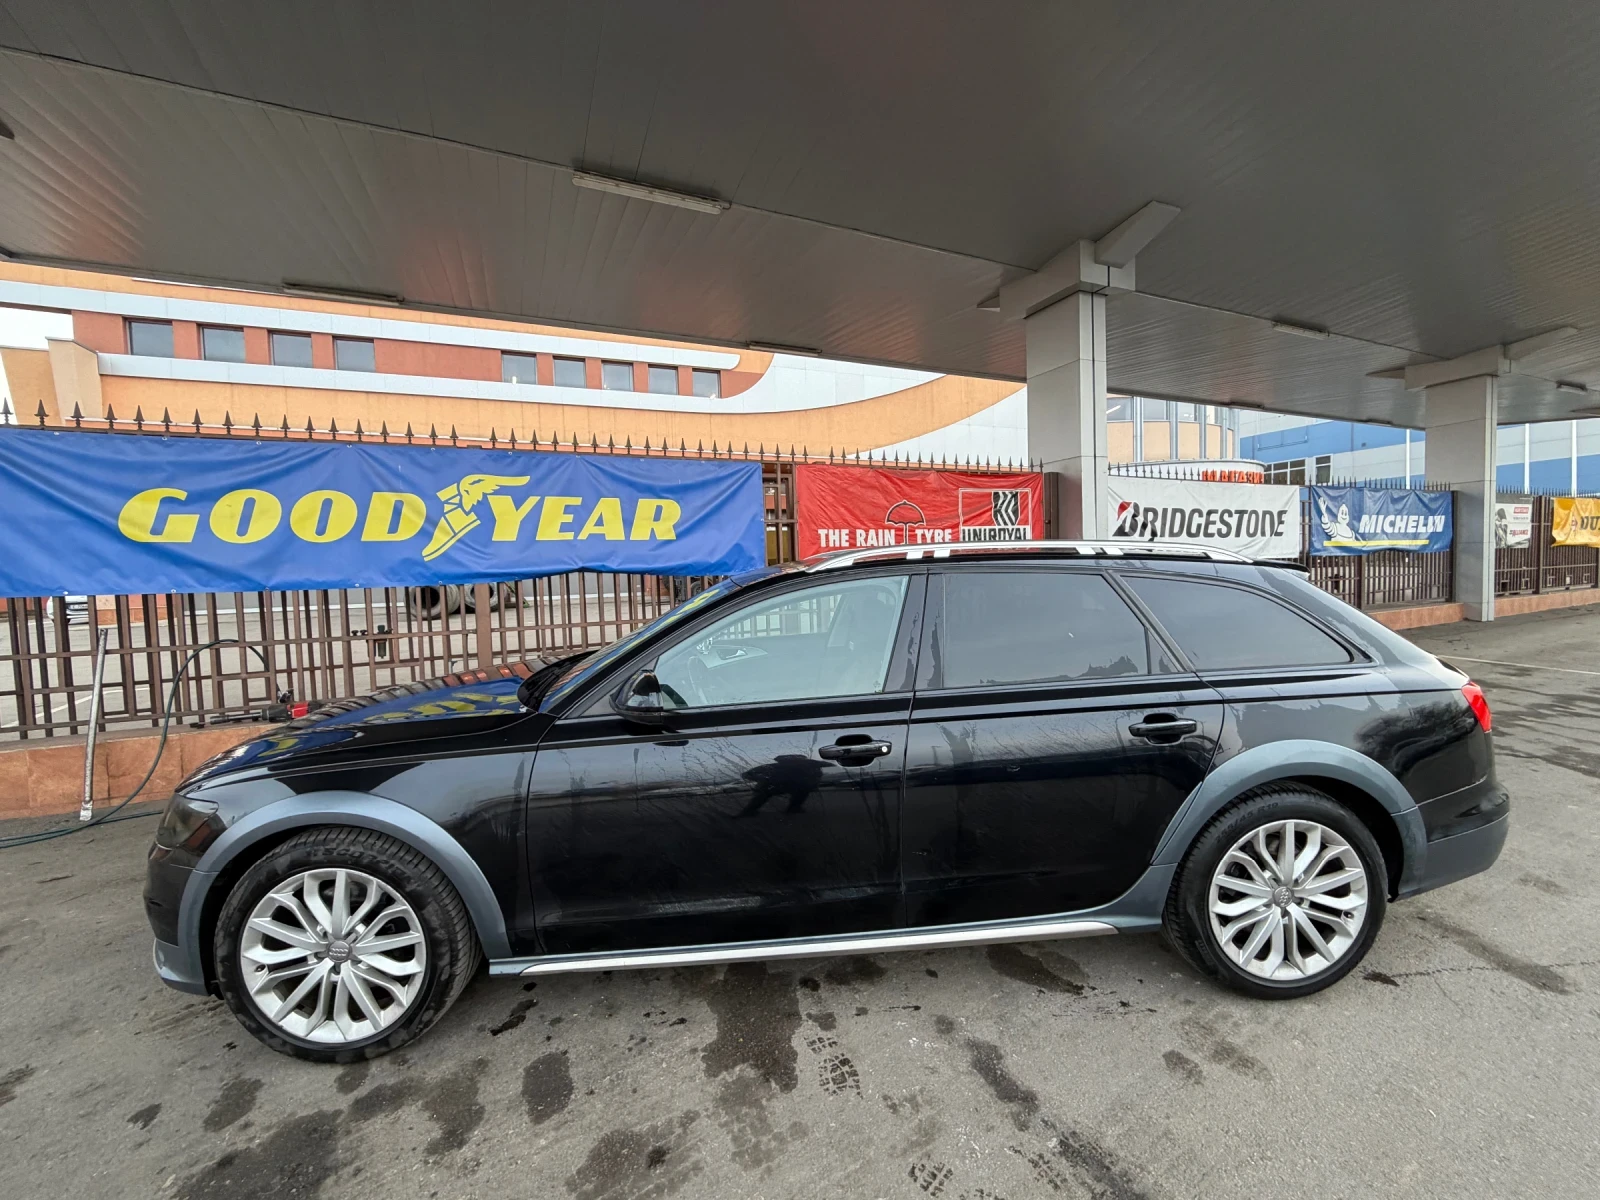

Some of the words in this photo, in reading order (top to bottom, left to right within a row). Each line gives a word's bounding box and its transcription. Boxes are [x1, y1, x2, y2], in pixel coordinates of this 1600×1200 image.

[1112, 501, 1288, 540] BRIDGESTONE
[1358, 514, 1446, 534] MICHELIN
[817, 528, 850, 548] THE
[855, 528, 896, 547] RAIN
[914, 528, 952, 543] TYRE
